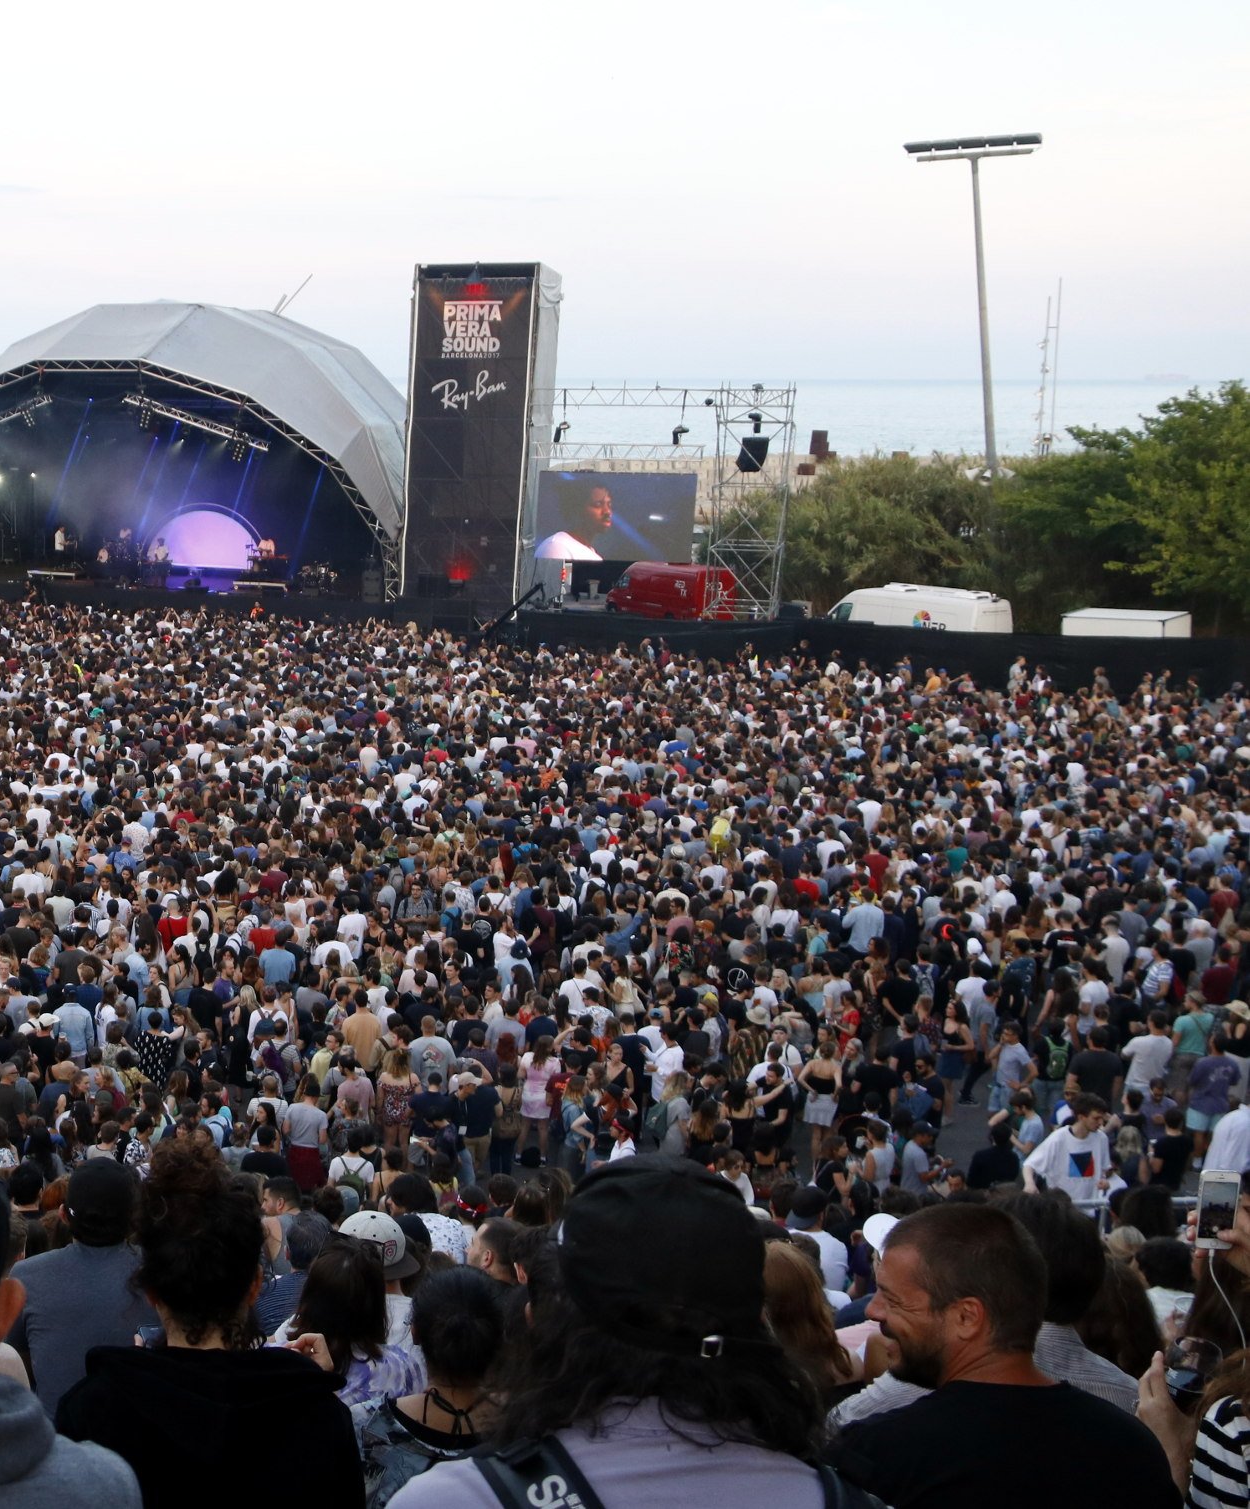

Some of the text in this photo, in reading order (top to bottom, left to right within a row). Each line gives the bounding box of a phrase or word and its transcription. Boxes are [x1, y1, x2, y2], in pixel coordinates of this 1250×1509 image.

[443, 304, 501, 321] PRIMA
[444, 321, 491, 337] VERA
[442, 337, 500, 352] SOUND
[431, 370, 506, 410] Ray-Ban
